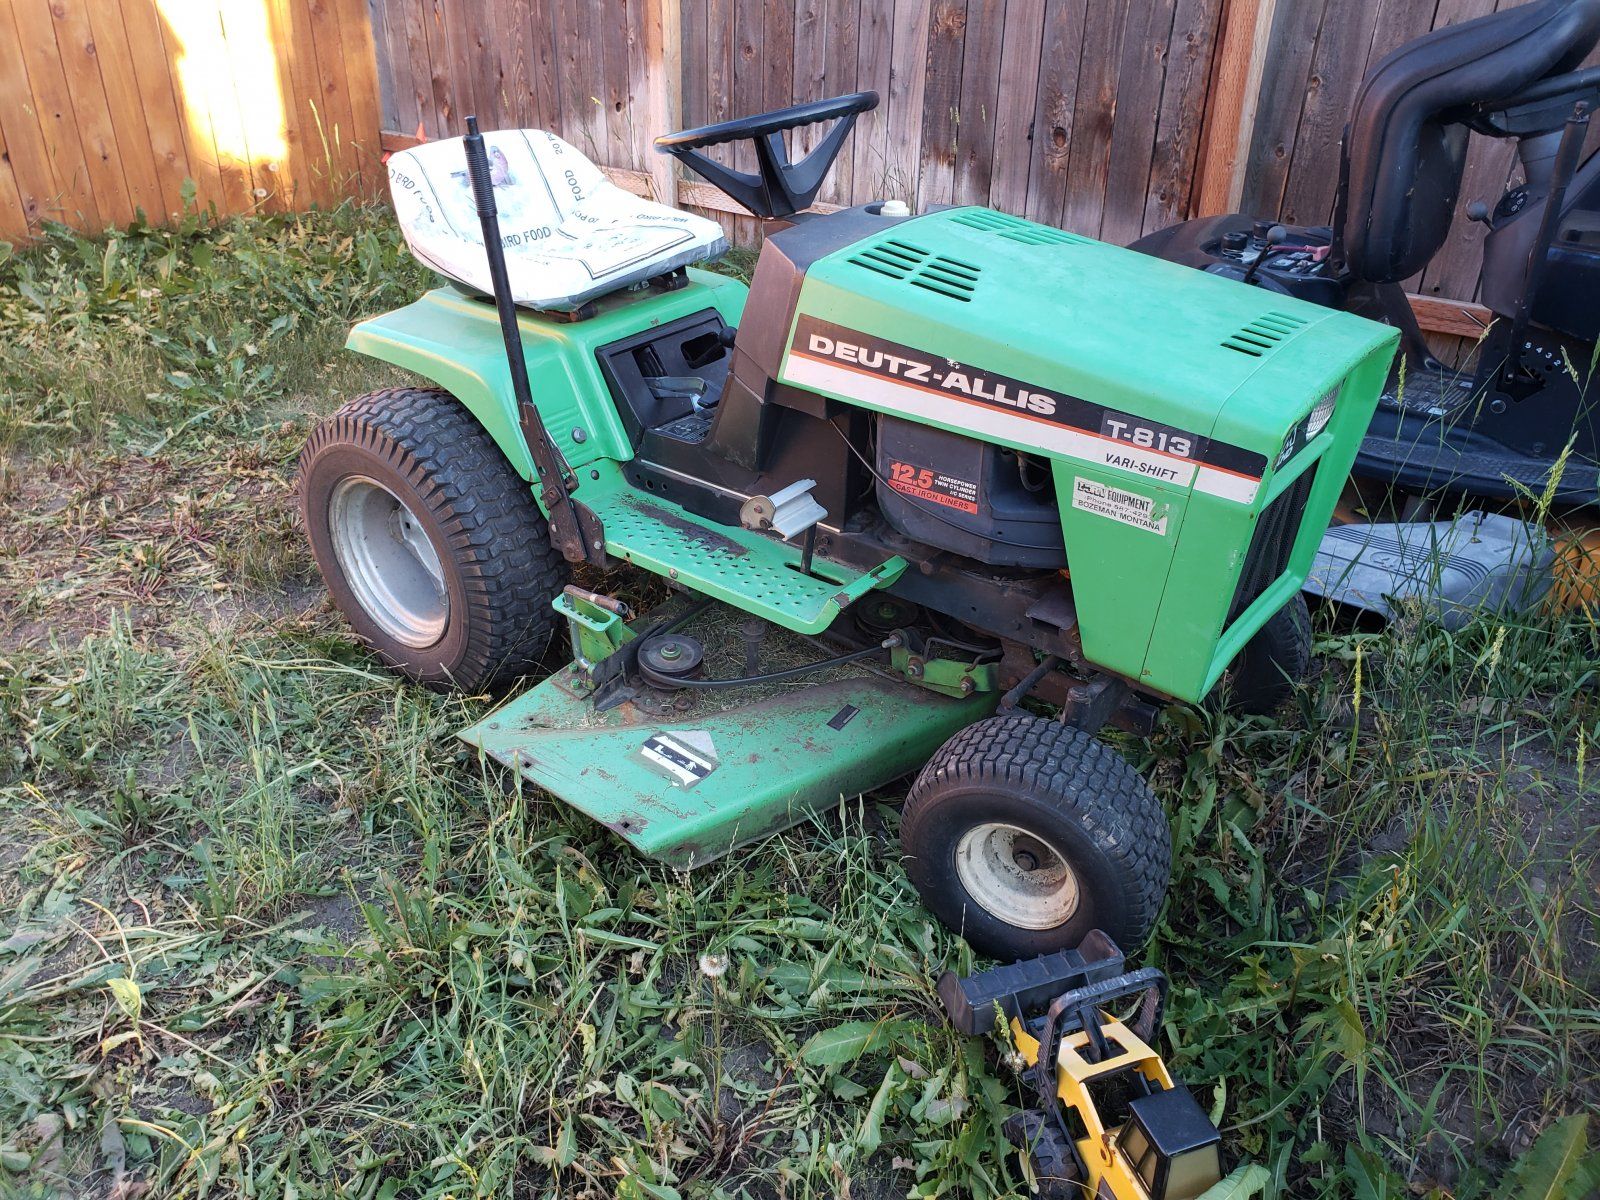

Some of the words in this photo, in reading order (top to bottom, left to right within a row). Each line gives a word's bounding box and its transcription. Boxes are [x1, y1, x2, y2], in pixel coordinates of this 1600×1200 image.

[565, 169, 585, 202] FOOD
[523, 226, 552, 243] FOOD
[1525, 341, 1532, 349] 5
[1553, 359, 1561, 367] 2
[809, 334, 1056, 415] DEUTZ-ALLIS
[1107, 420, 1191, 458] T-813
[890, 462, 934, 489] 12.5
[1106, 453, 1178, 480] VARI-SHIFT
[934, 479, 949, 489] TWIN
[949, 483, 976, 496] CYLINDER
[938, 475, 977, 490] HORSEPOWER
[896, 483, 917, 495] CAST
[917, 490, 939, 501] IRON
[940, 496, 969, 510] LINERS
[958, 491, 976, 502] SERIES
[1086, 495, 1112, 508] Phone
[1114, 504, 1152, 519] 587-429
[1107, 489, 1150, 512] EQUIPMENT
[1078, 499, 1117, 517] BOZEMAN
[1119, 513, 1160, 532] MONTANA
